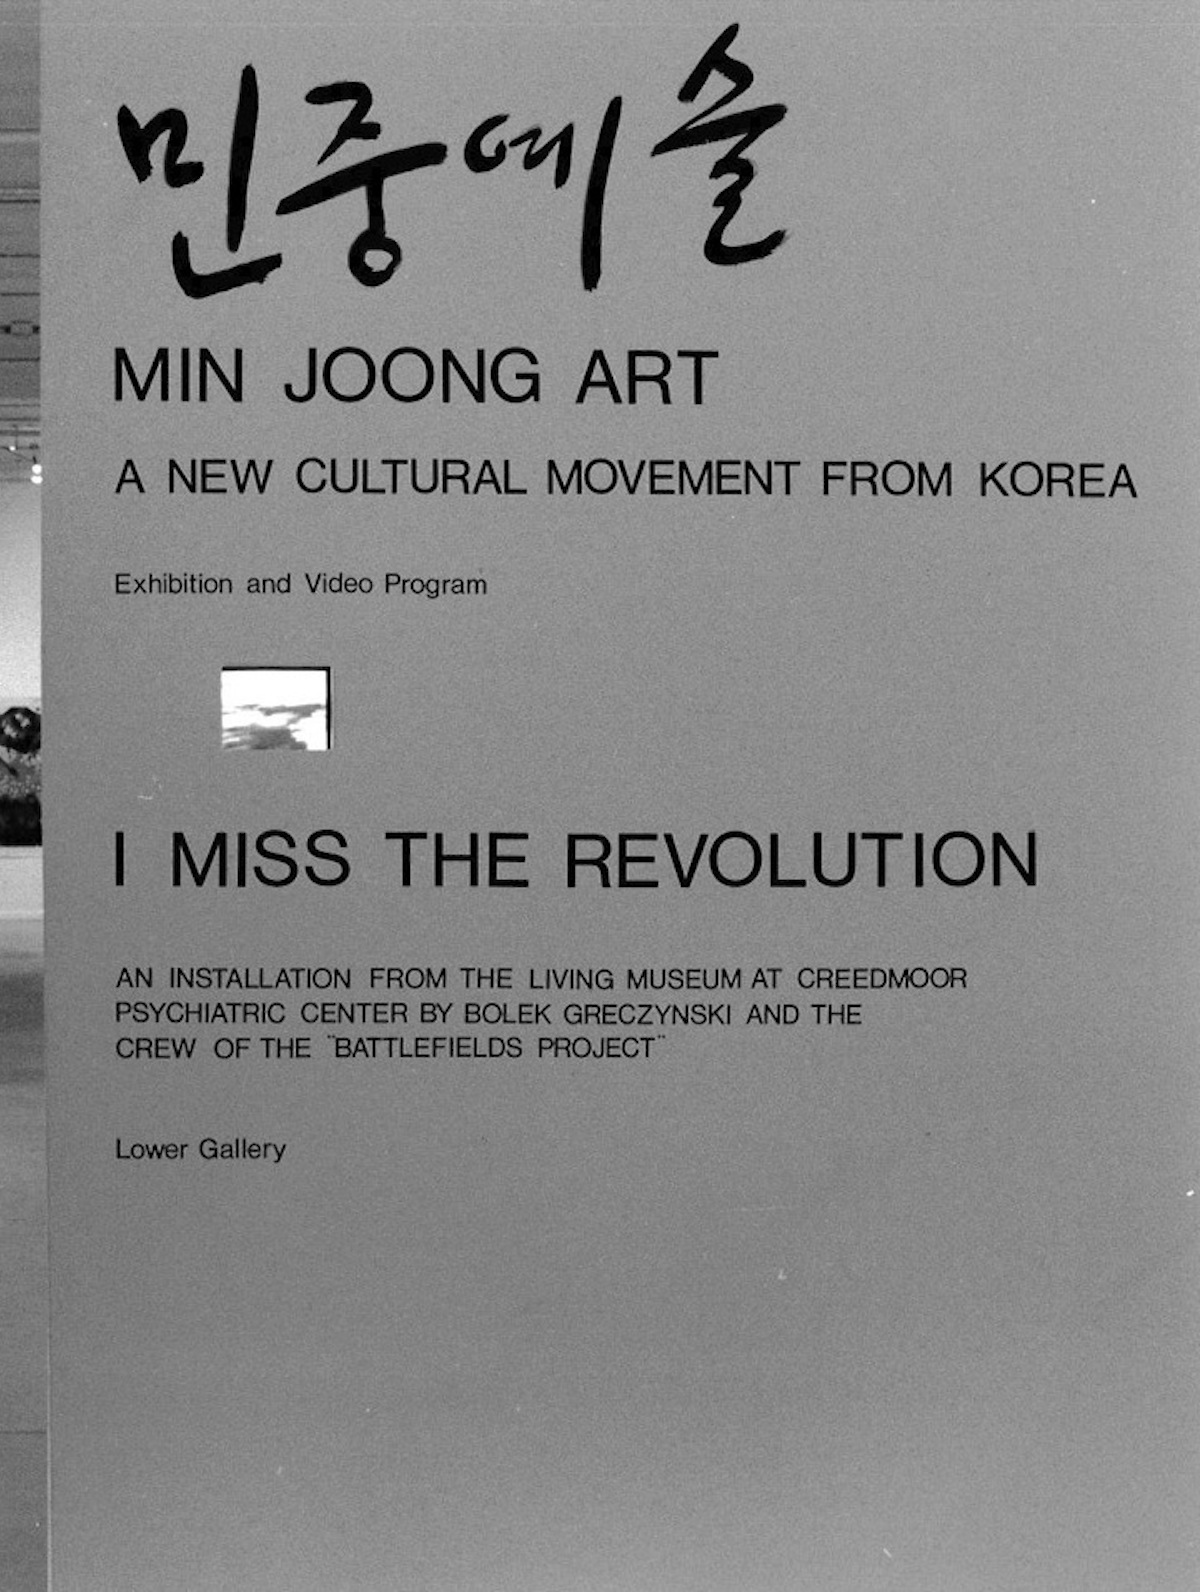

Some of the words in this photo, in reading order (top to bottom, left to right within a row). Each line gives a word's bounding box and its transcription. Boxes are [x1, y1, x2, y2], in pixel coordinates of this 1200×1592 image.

[116, 22, 788, 300] 민중예술
[115, 347, 243, 403] MIN
[284, 346, 540, 404] JOONG
[575, 349, 719, 405] ART
[115, 458, 145, 494] A
[168, 458, 274, 494] NEW
[296, 457, 528, 495] CULTURAL
[547, 458, 801, 496] MOVEMENT
[823, 459, 952, 497] FROM
[980, 461, 1138, 498] KOREA
[115, 573, 233, 595] Exhibition
[246, 573, 291, 594] and
[305, 572, 373, 594] Video
[385, 573, 487, 599] Program
[115, 831, 125, 887] I
[172, 829, 351, 888] MISS
[384, 831, 530, 888] THE
[567, 830, 1037, 889] REVOLUTION
[115, 967, 153, 989] AN
[170, 967, 351, 990] INSTALLATION
[370, 967, 447, 990] FROM
[460, 967, 513, 989] THE
[529, 968, 614, 991] LIVING
[627, 968, 742, 990] MUSEUM
[751, 967, 782, 989] AT
[797, 967, 967, 989] CREEDMOOR
[115, 1001, 286, 1024] PSYCHIATRIC
[300, 1002, 408, 1024] CENTER
[420, 1002, 453, 1024] BY
[464, 1002, 552, 1025] BOLEK
[563, 1003, 731, 1025] GRECZYNSKI
[746, 1003, 800, 1025] AND
[810, 1003, 862, 1025] THE
[115, 1037, 197, 1059] CREW
[213, 1037, 251, 1060] OF
[259, 1037, 311, 1059] THE
[116, 1138, 189, 1160] Lower
[198, 1137, 287, 1164] Gallery
